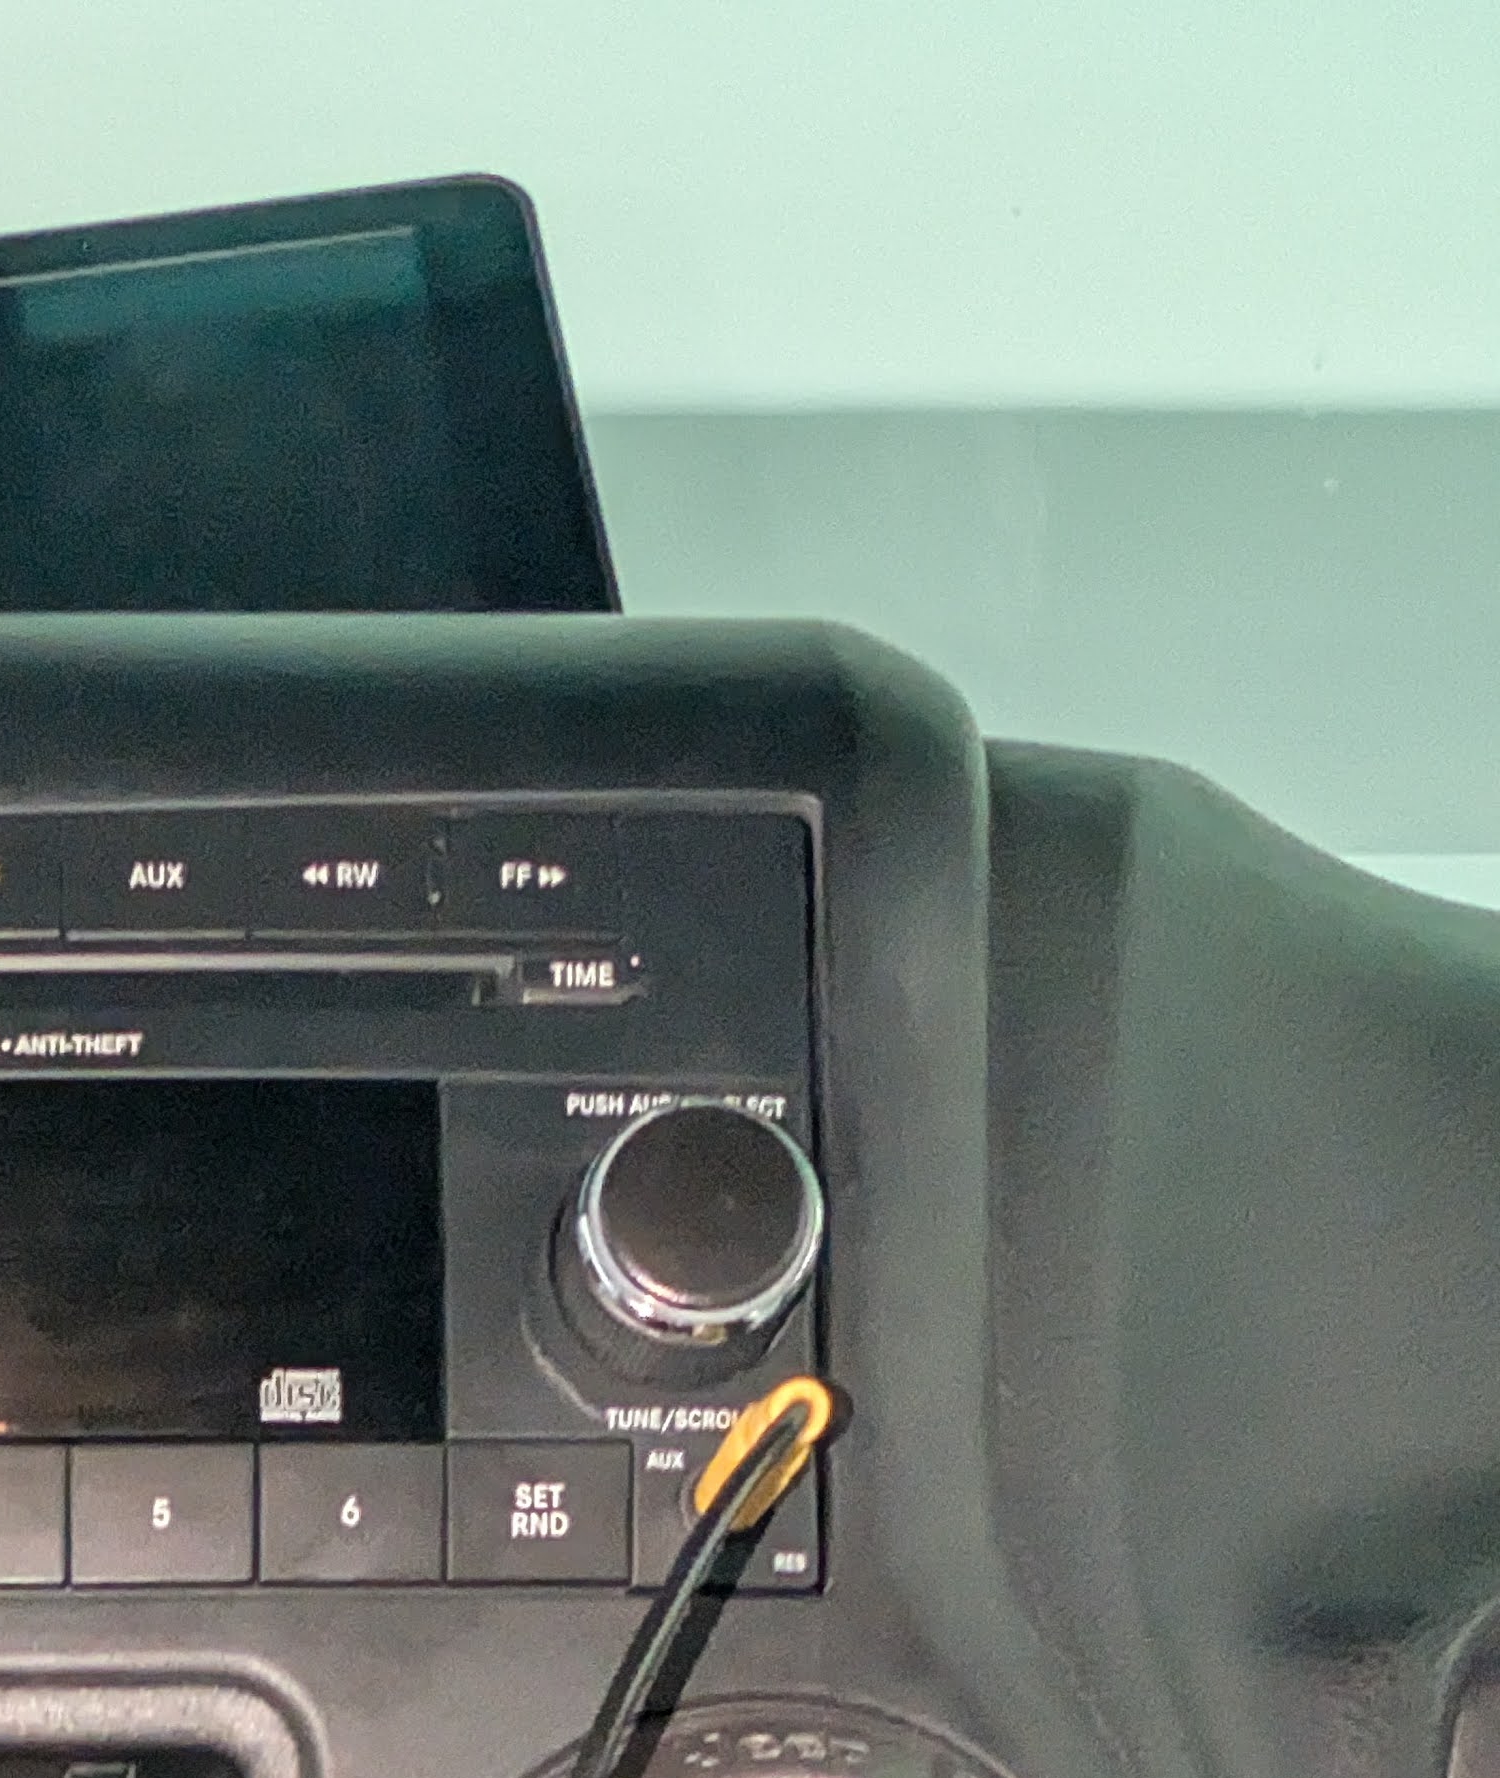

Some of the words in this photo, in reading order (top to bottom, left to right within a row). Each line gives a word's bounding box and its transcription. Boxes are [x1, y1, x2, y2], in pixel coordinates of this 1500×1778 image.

[128, 861, 185, 890] AUX
[335, 860, 380, 889] RW
[500, 861, 533, 890] FF
[549, 960, 615, 989] TIME
[12, 1032, 143, 1057] ANTI-THEFT
[565, 1093, 624, 1117] PUSH
[645, 1448, 685, 1471] AUX
[339, 1494, 363, 1529] 6
[513, 1483, 566, 1511] SET
[151, 1496, 173, 1531] 5
[510, 1511, 570, 1540] RND
